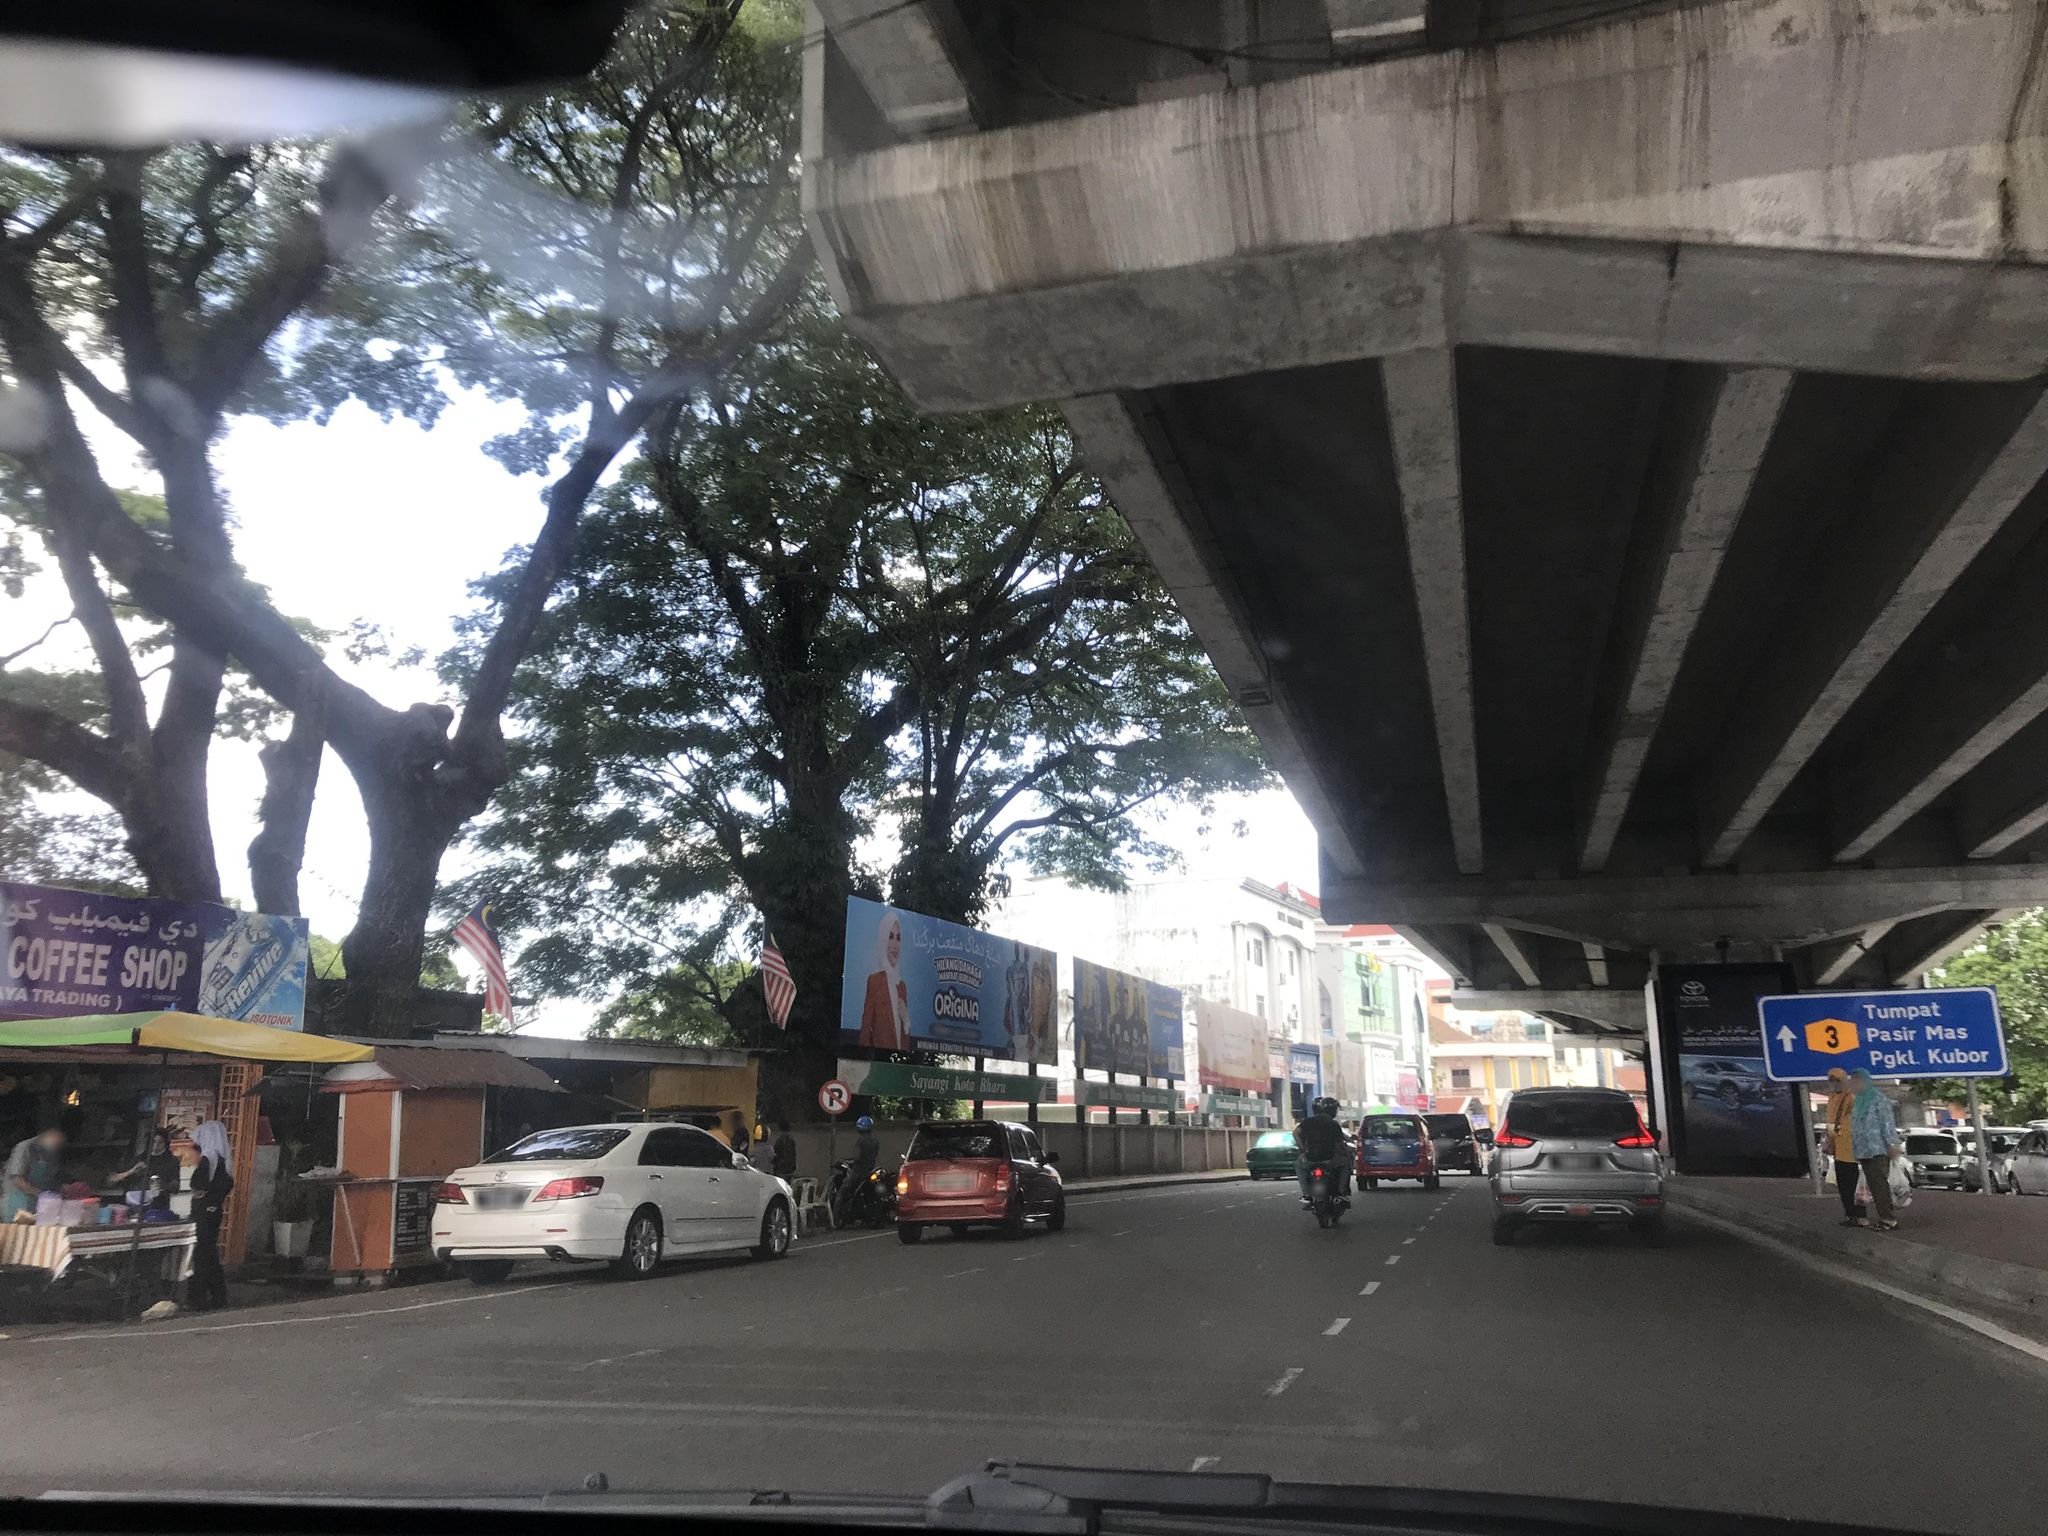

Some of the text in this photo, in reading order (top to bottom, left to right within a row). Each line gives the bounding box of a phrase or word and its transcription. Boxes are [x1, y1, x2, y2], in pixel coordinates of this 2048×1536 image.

[7, 935, 112, 987] COFFEE
[120, 945, 188, 991] SHOP
[0, 986, 28, 1002] YA
[32, 988, 111, 1008] TRADING
[249, 1013, 295, 1025] ISOTONIK
[1862, 1002, 1942, 1021] Tumpat
[1825, 1025, 1840, 1049] 3
[1866, 1025, 1969, 1043] Pasir Mas
[1928, 1049, 1989, 1065] Kubor
[910, 1072, 1006, 1094] Sayangi Kota Bharu
